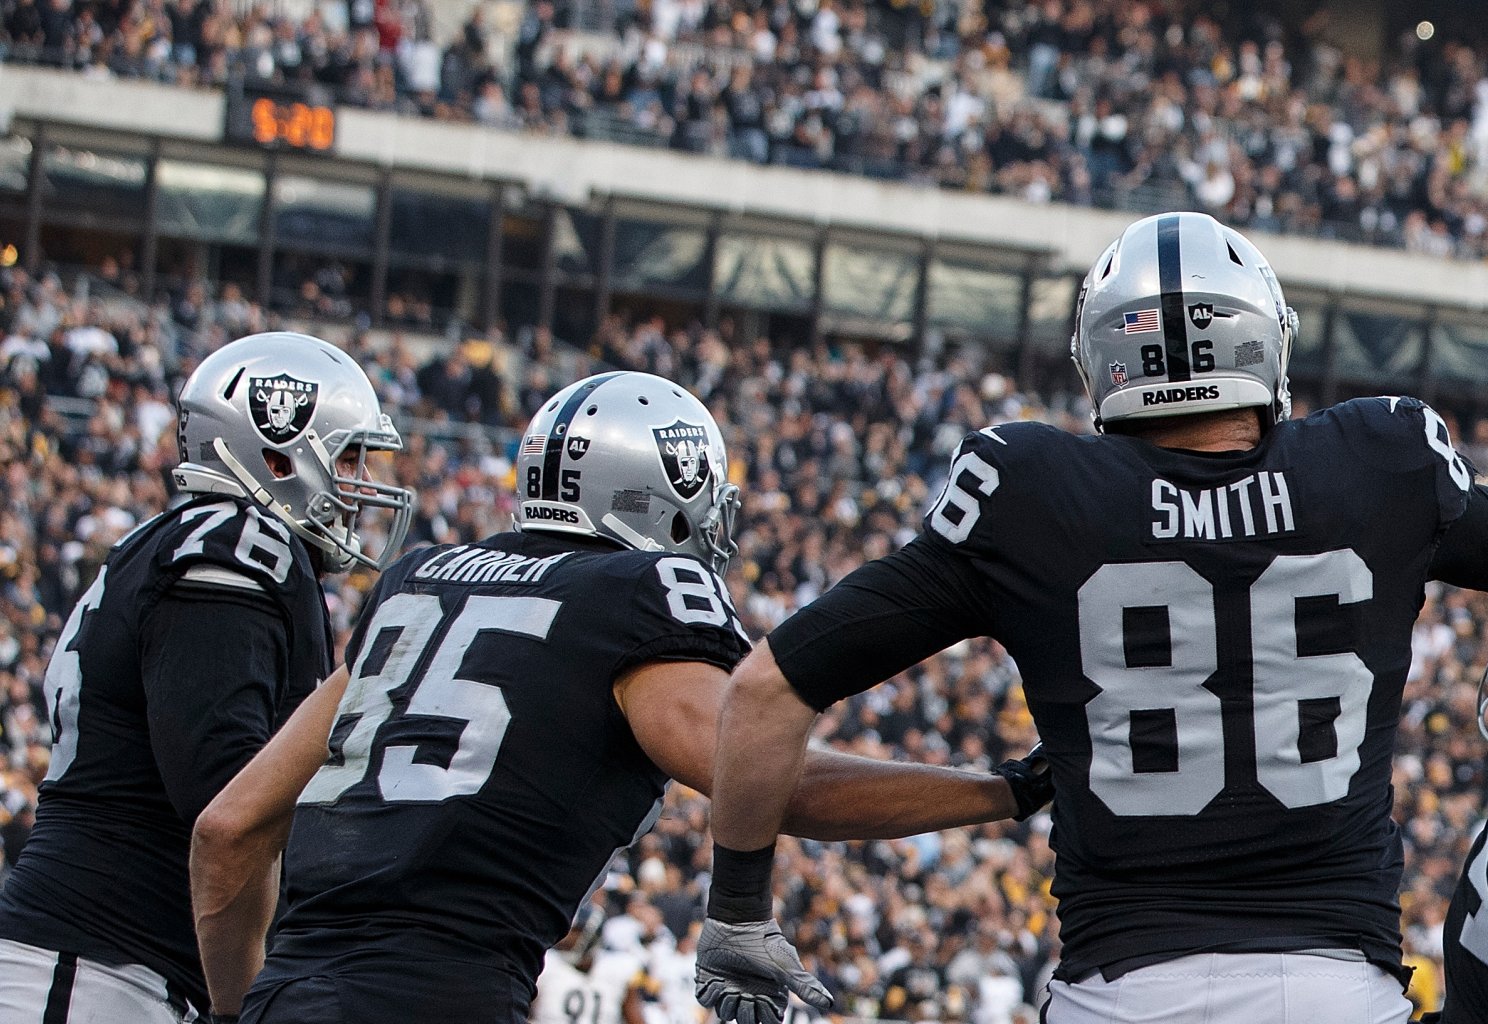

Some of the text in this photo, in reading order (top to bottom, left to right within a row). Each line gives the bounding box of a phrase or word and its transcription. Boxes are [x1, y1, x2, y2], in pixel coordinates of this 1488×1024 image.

[1192, 308, 1211, 320] AL
[255, 378, 313, 393] RAIDERS
[1112, 372, 1128, 387] NFL
[1142, 385, 1220, 406] RAIDERS
[659, 427, 704, 439] RAIDERS
[569, 440, 586, 452] AL
[1151, 470, 1296, 540] SMITH
[526, 507, 579, 524] RAIDERS
[173, 501, 294, 584] 76
[1077, 547, 1375, 817] 86
[296, 592, 563, 803] 85
